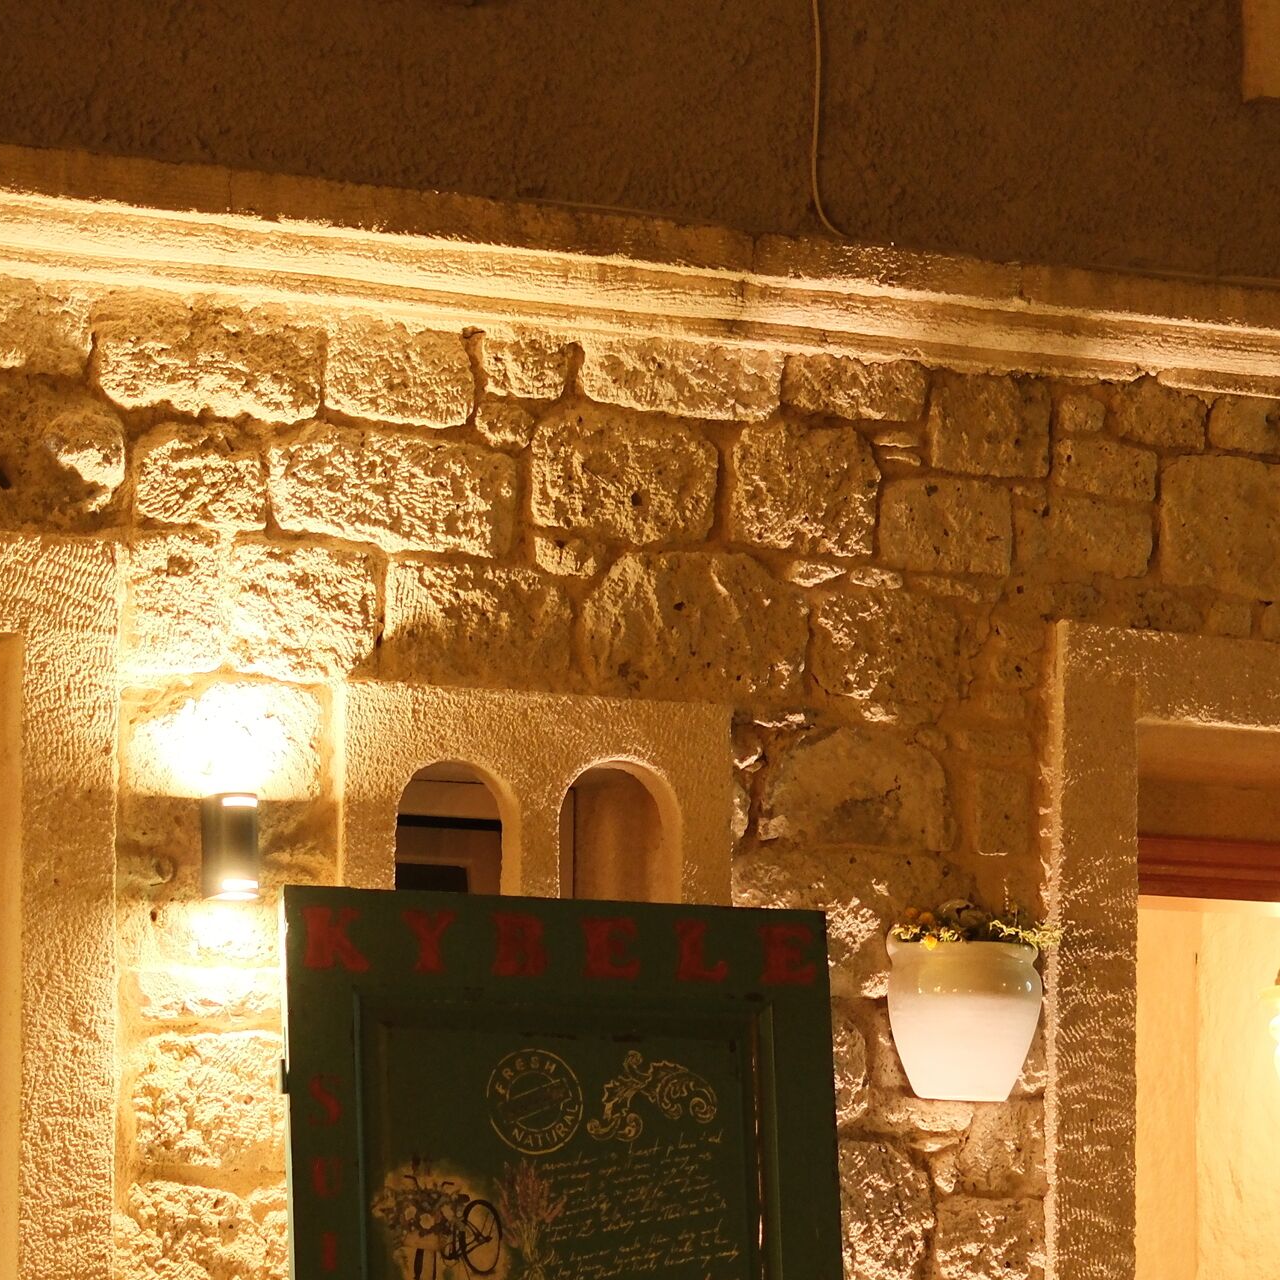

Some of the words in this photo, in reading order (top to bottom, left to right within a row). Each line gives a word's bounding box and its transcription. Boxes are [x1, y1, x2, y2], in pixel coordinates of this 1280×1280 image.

[300, 905, 817, 985] KYBELE
[495, 1056, 557, 1095] FRESH
[511, 1103, 579, 1148] NATURAL
